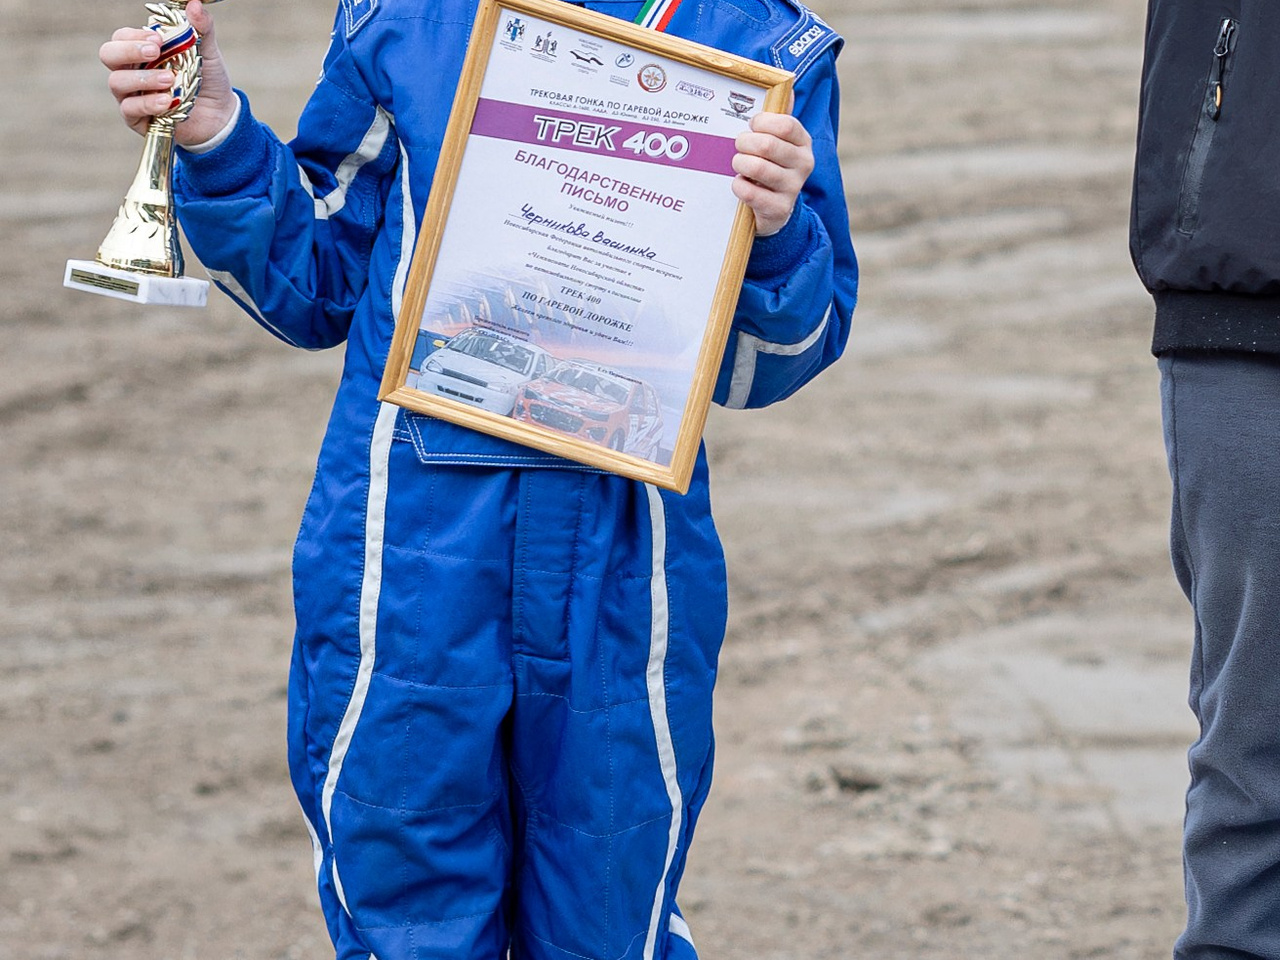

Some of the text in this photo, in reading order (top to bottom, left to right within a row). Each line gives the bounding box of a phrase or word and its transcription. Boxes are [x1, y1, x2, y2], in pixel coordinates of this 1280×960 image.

[788, 24, 826, 58] sparco
[530, 88, 573, 101] ТРЕКОВАЯ
[574, 96, 604, 107] ГОНКА
[606, 101, 620, 109] ПО
[622, 103, 661, 116] ГАРЕВОЙ
[662, 110, 709, 123] ДОРОЖКЕ
[533, 115, 688, 159] ТРЕК 400
[514, 150, 684, 211] БЛАГОДАРСТВЕННОЕ
[560, 182, 628, 211] ПИСЬМО
[521, 291, 633, 332] ПО ГАРЕВОЙ ДОРОЖКЕ
[559, 285, 601, 304] ТРЕК 400
